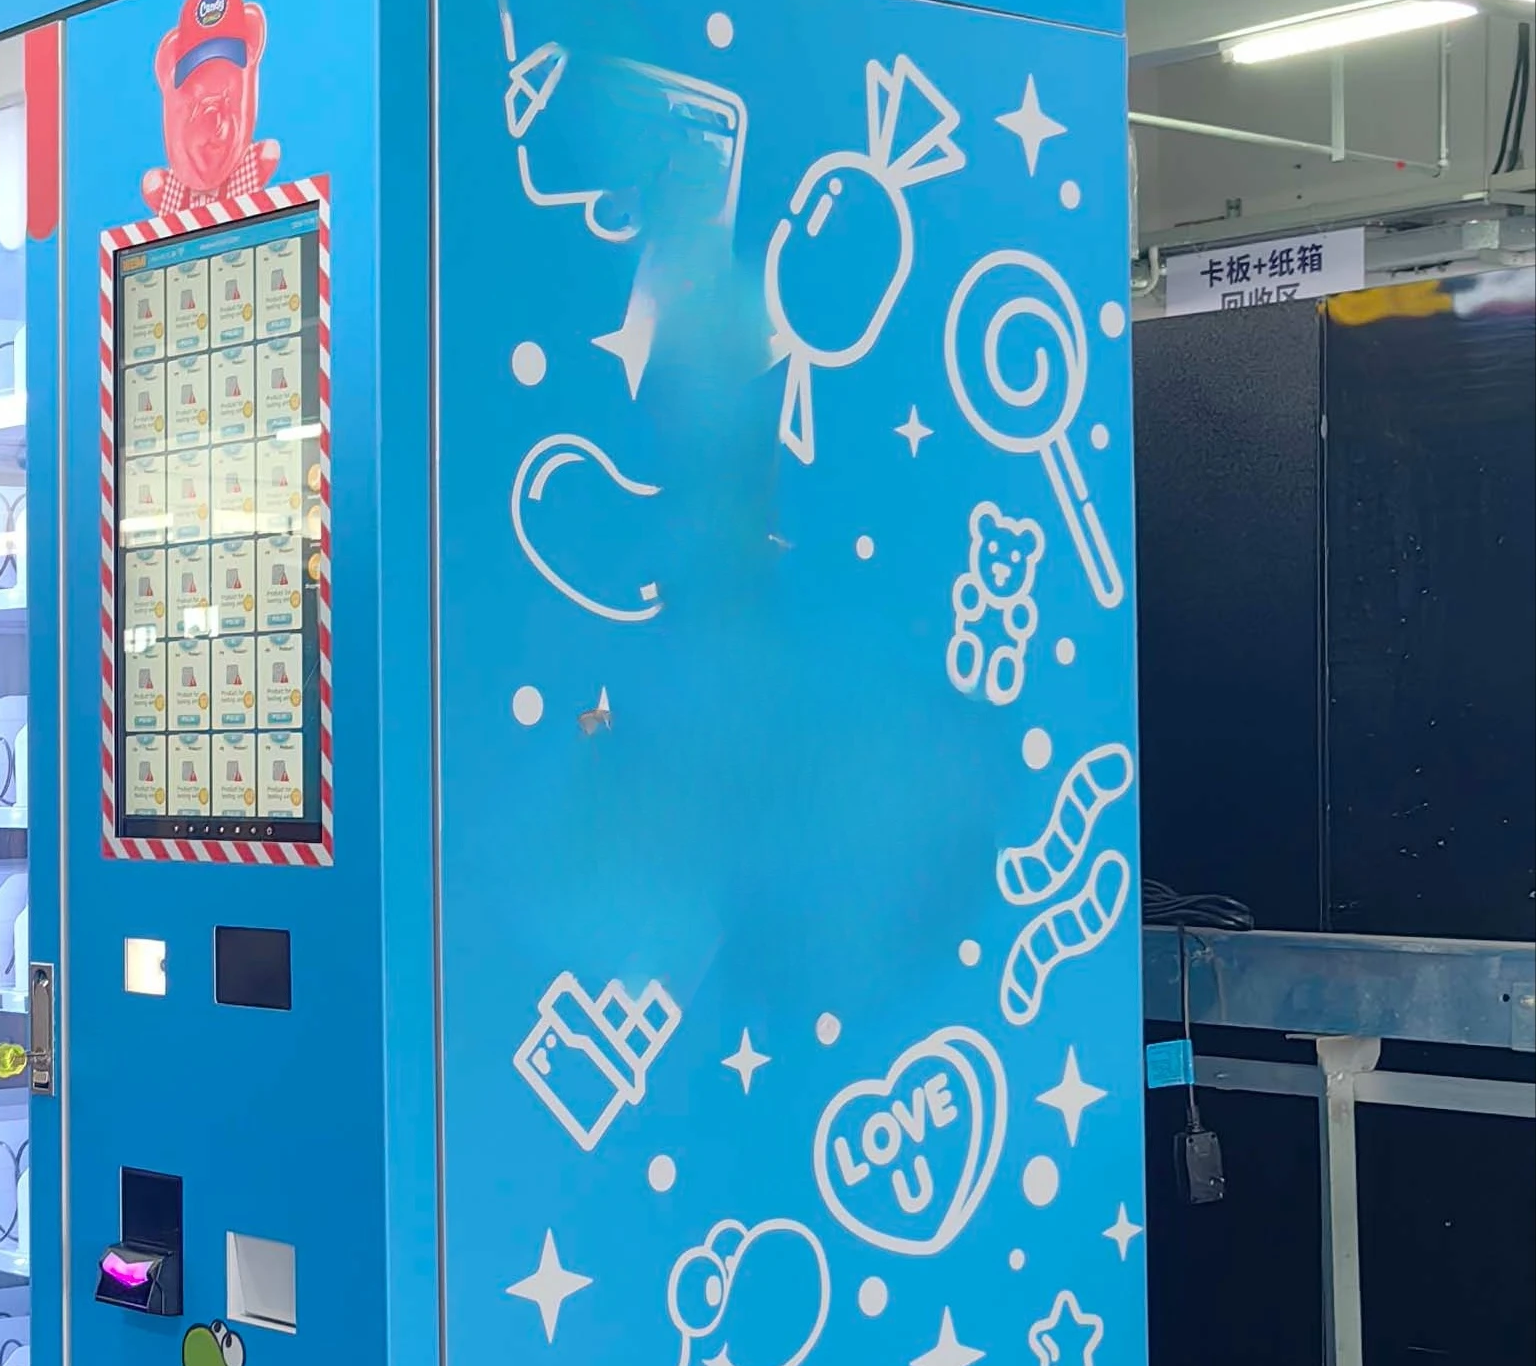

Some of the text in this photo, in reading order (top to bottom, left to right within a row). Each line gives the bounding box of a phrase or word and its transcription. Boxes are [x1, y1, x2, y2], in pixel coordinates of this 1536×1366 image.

[1200, 243, 1323, 288] 卡板+纸箱
[834, 1073, 958, 1186] LOVE
[893, 1155, 933, 1213] U
